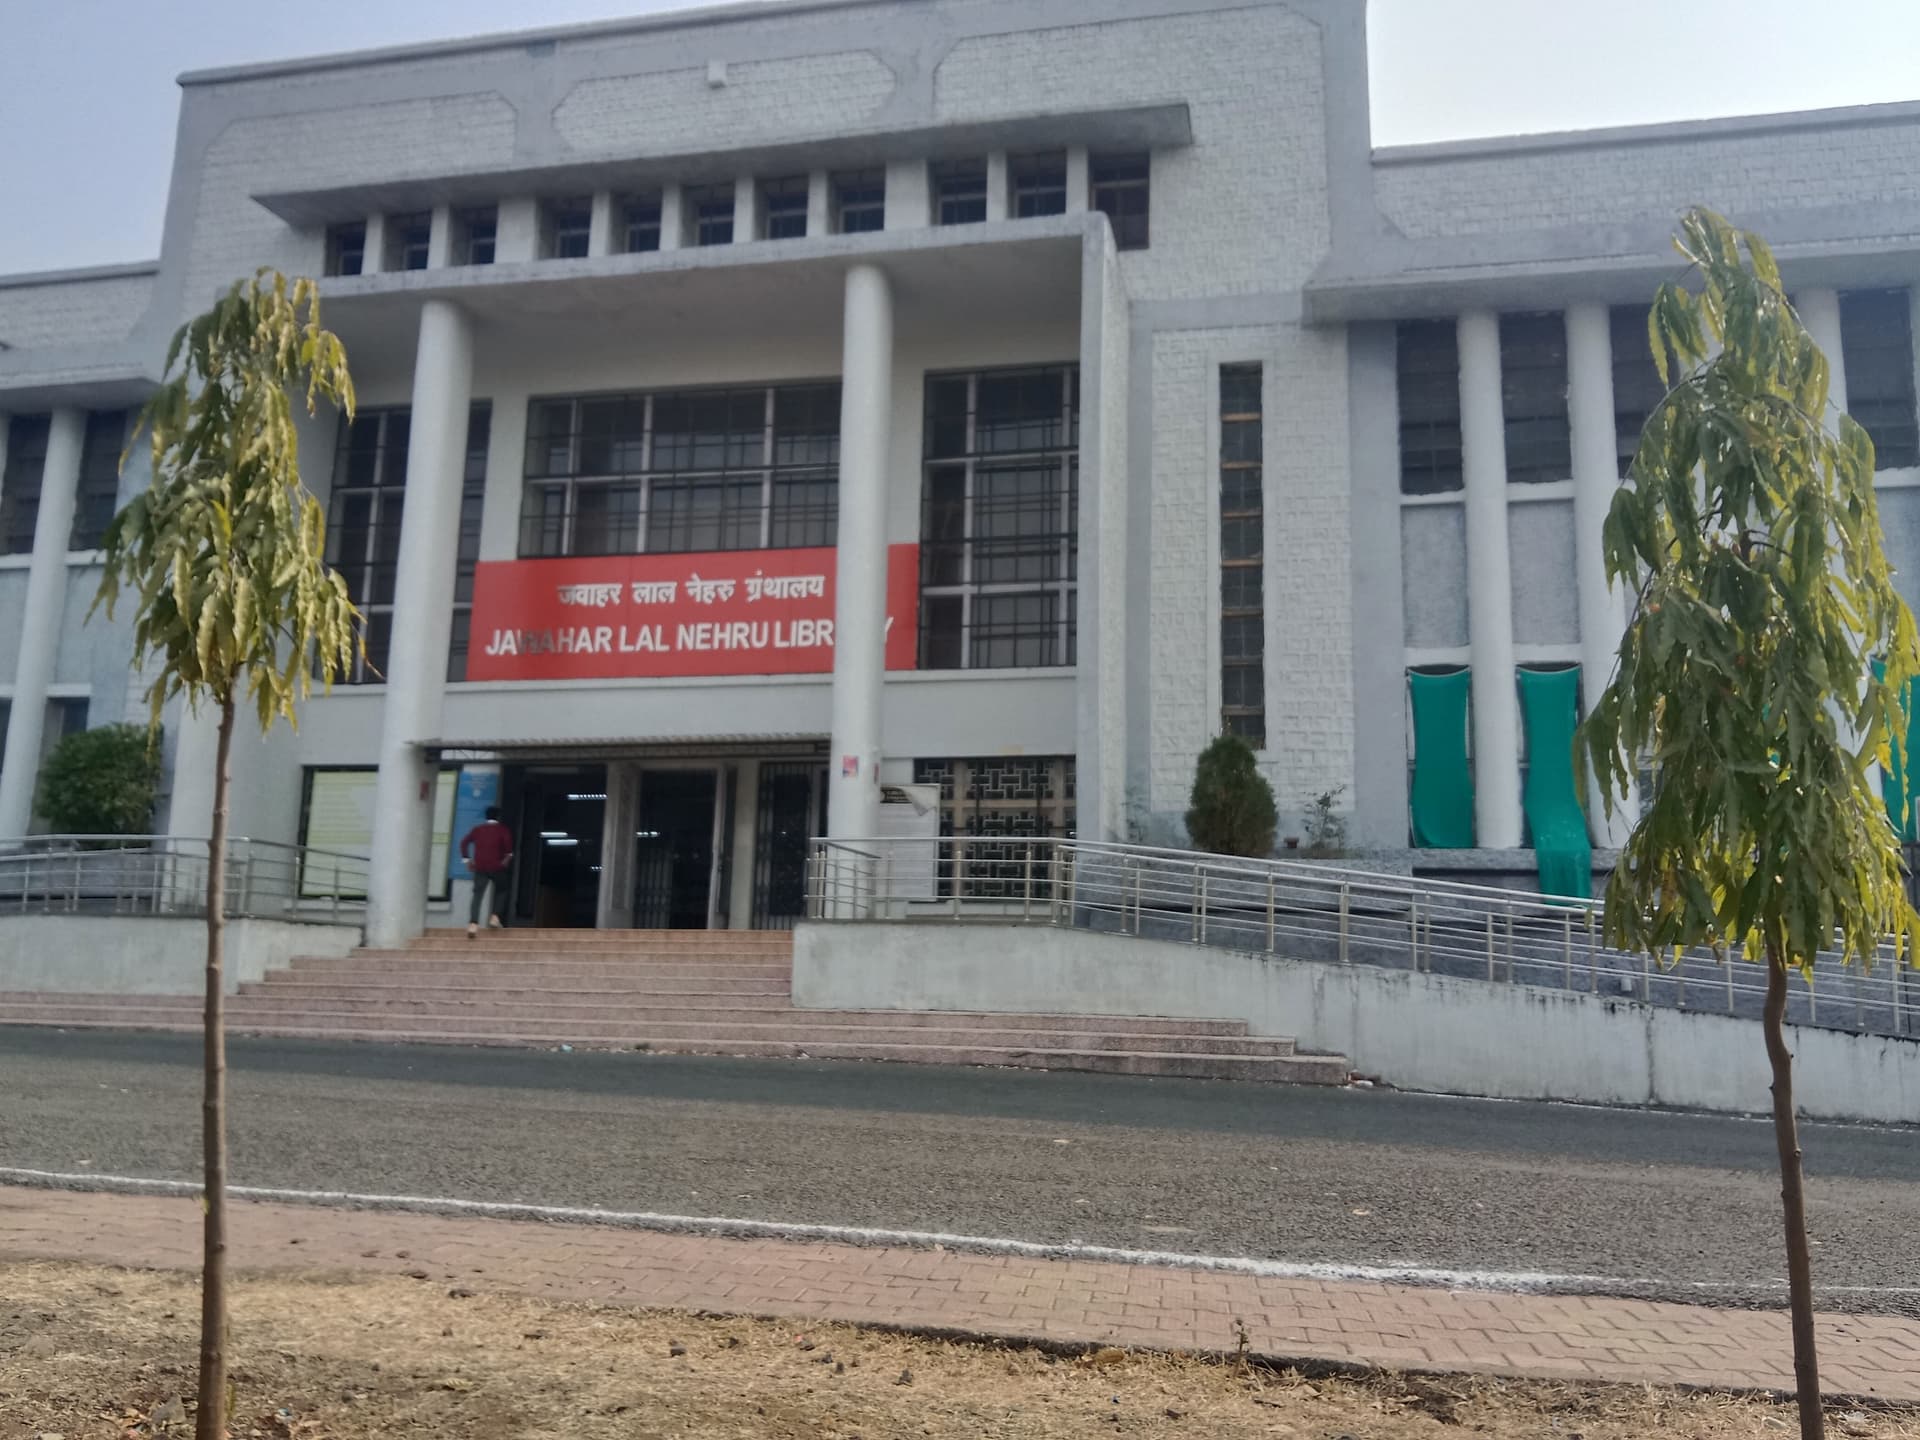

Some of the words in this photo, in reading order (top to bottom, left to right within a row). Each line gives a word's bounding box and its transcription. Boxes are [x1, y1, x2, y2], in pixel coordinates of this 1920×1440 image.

[557, 583, 622, 607] जवाहर
[631, 581, 677, 604] लाल
[745, 569, 825, 602] ग्रंथालय
[619, 624, 671, 652] LAL
[677, 621, 769, 650] NEHRU
[774, 616, 894, 648] LIBR
